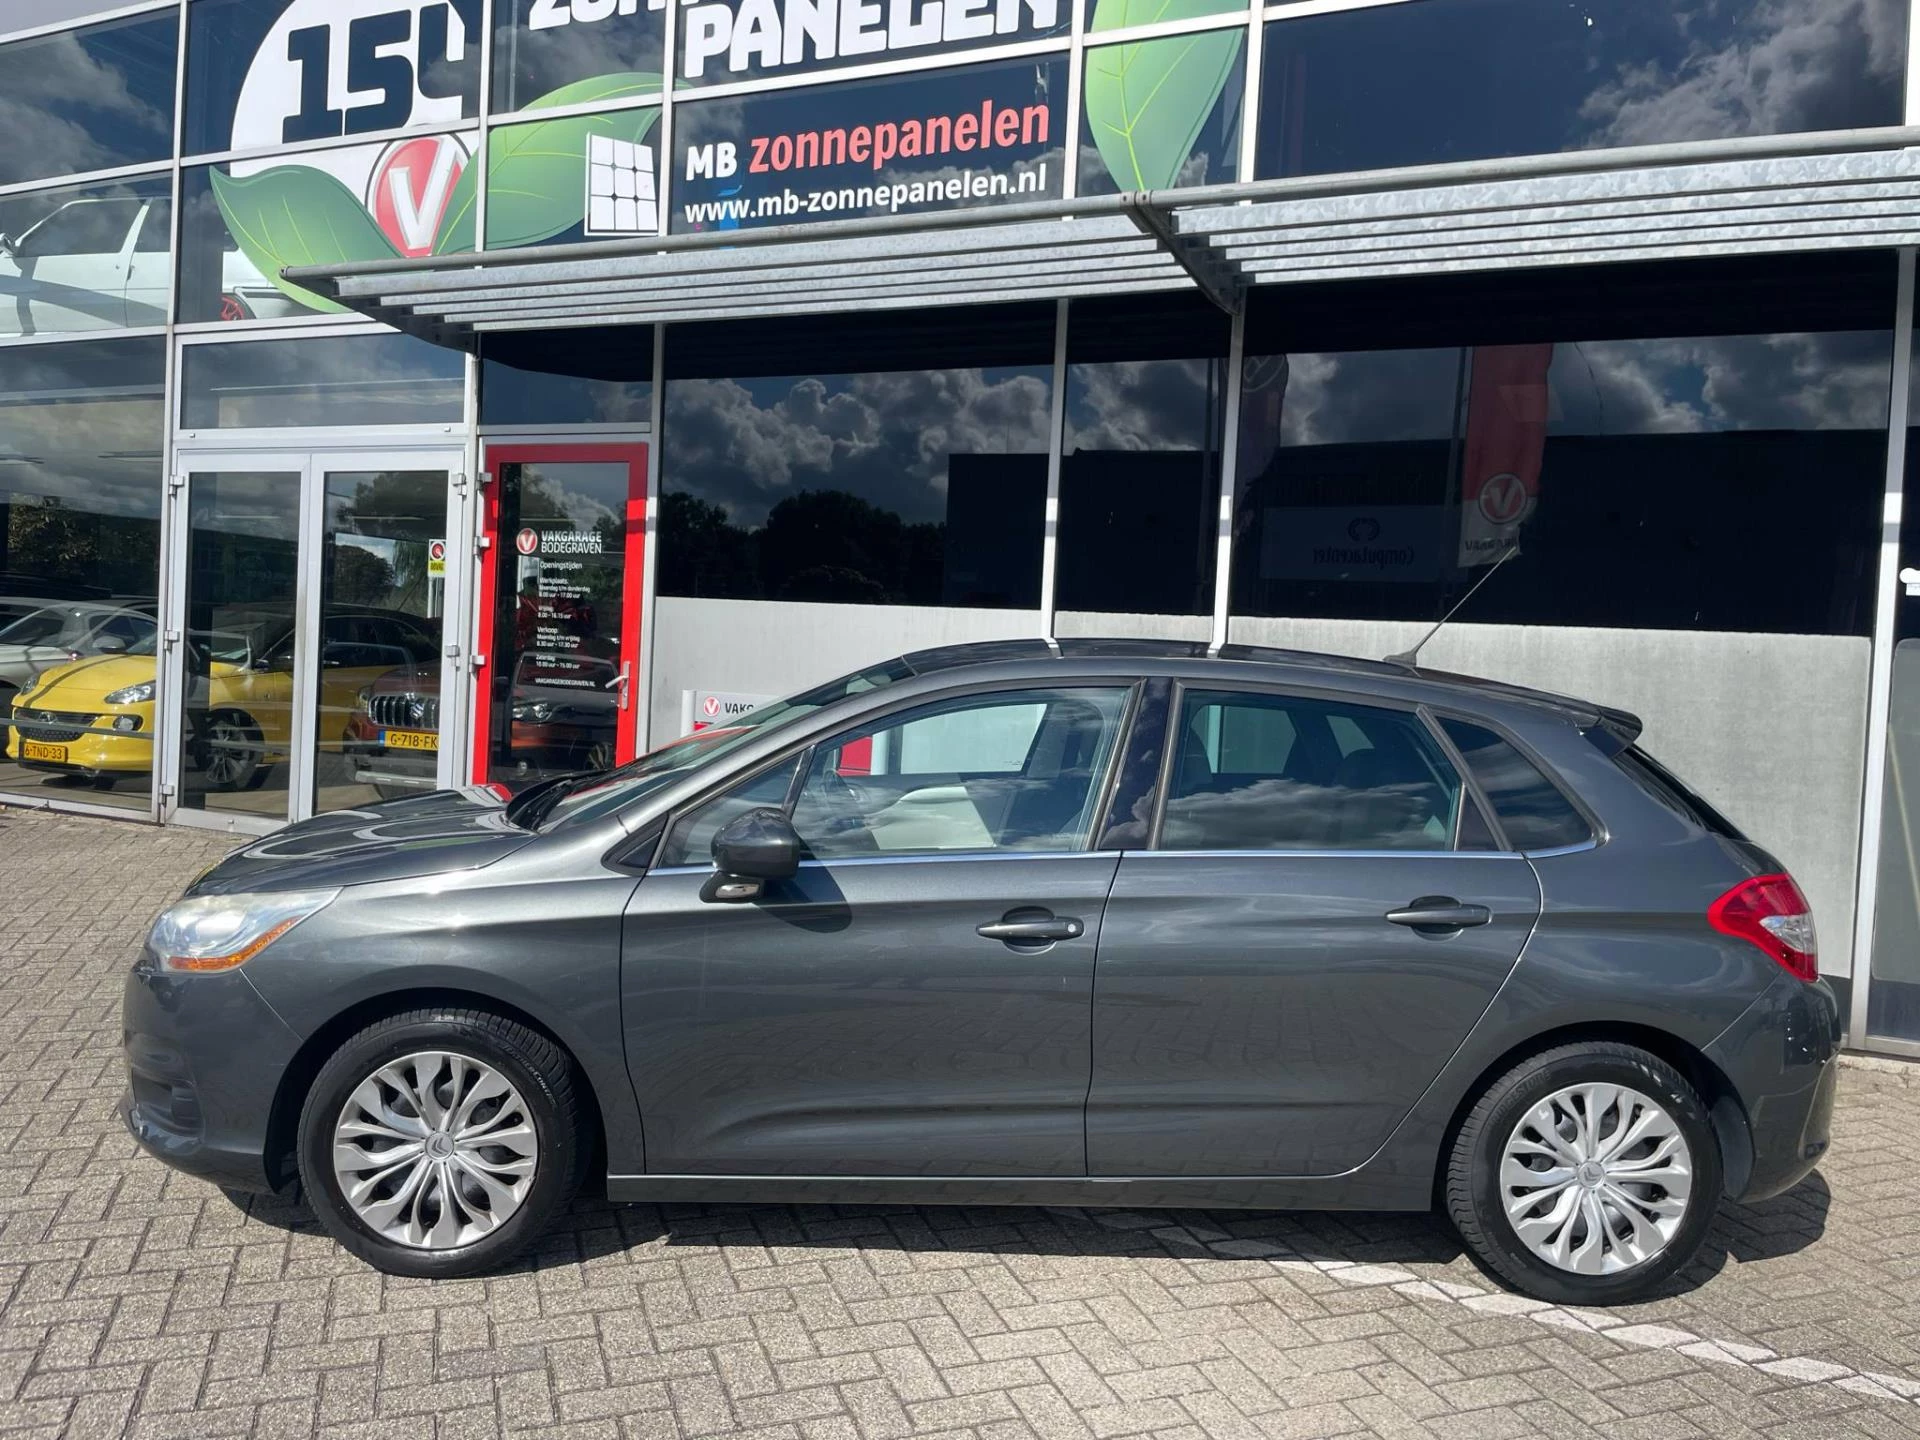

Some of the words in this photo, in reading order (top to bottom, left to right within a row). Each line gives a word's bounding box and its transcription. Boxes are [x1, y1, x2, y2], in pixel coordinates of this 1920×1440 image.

[686, 141, 737, 181] MB
[749, 100, 1049, 174] zonnepanelen
[685, 163, 1047, 224] www.mb-zonnepanelen.nl
[541, 531, 602, 542] VAKGARAGE
[541, 542, 602, 554] BODEGRAVEN
[540, 561, 582, 570] Openingstijden
[390, 734, 438, 749] G-718-FK
[25, 744, 62, 759] 6-TND-33
